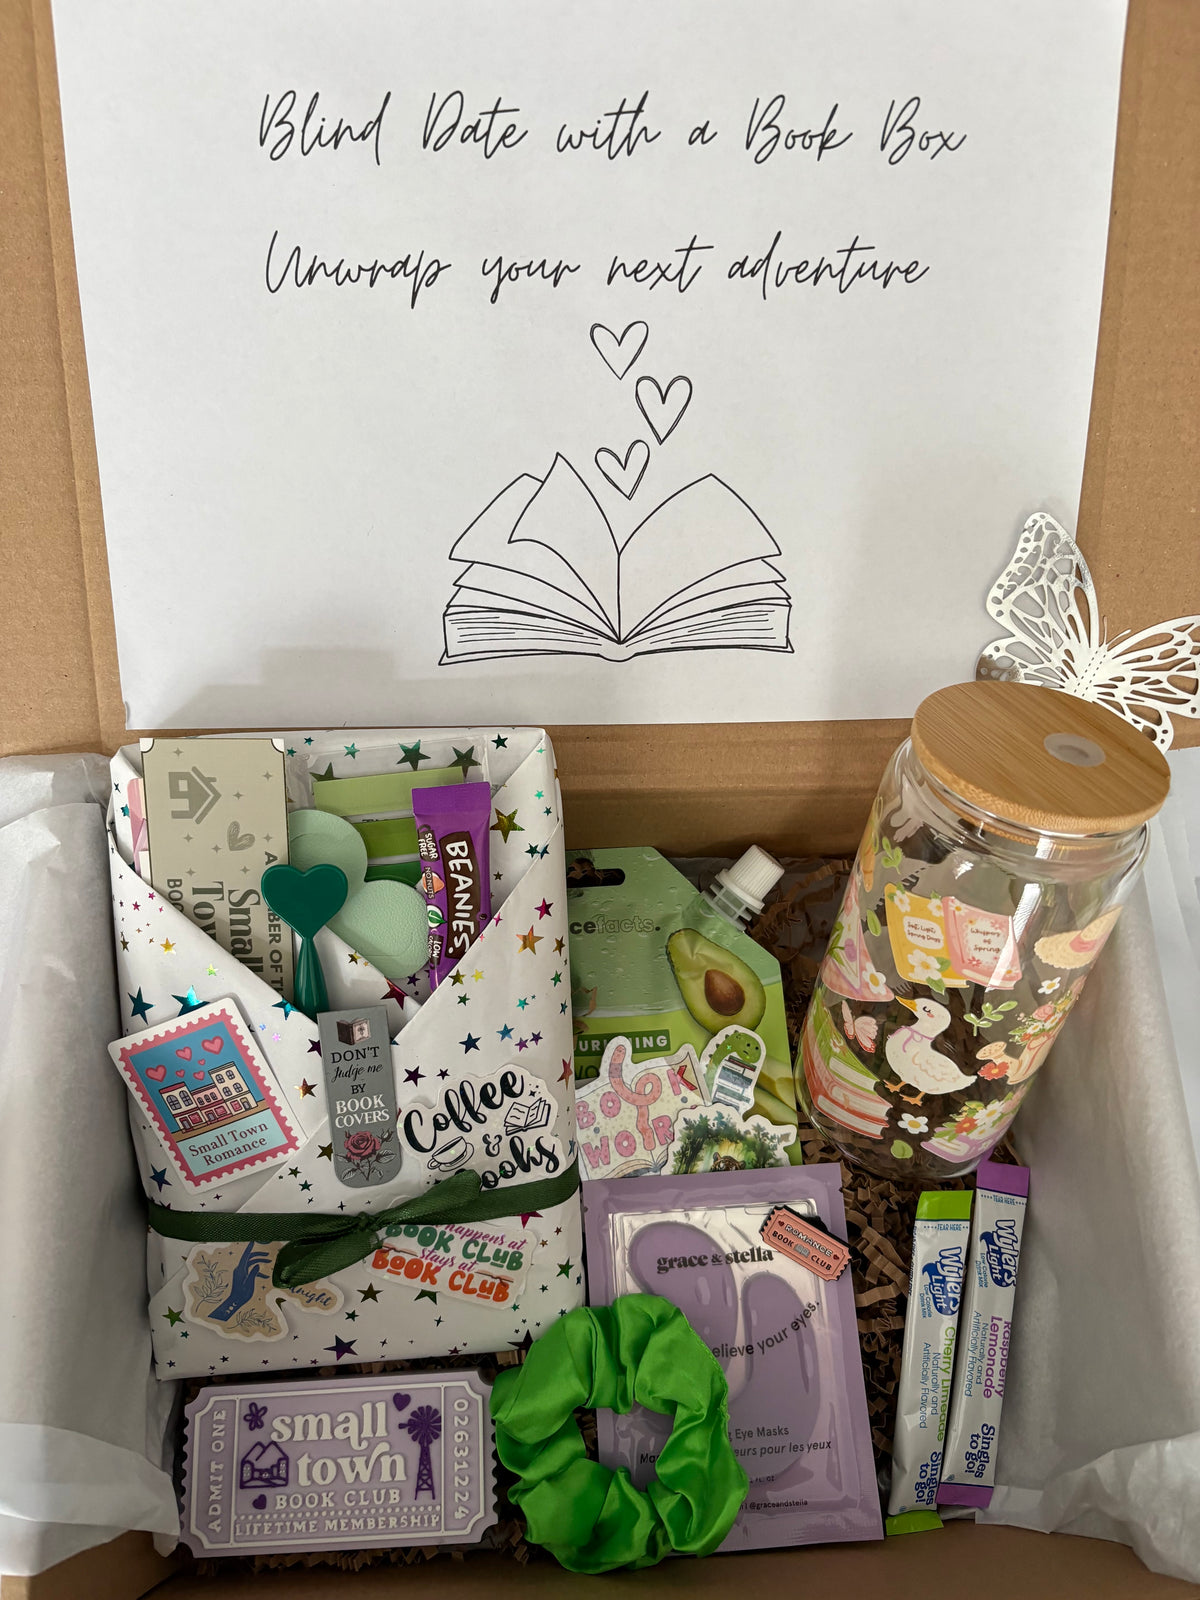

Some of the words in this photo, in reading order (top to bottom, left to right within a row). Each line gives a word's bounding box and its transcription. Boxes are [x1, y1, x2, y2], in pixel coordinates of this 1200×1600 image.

[259, 91, 391, 165] Blind
[423, 91, 528, 150] Date
[556, 91, 661, 158] with
[688, 119, 718, 146] a
[745, 94, 853, 164] Book
[880, 96, 967, 165] Box
[264, 230, 452, 310] Unwrap
[481, 256, 581, 304] your
[607, 235, 714, 292] next
[727, 230, 930, 301] adventure
[265, 851, 278, 866] A
[418, 838, 429, 857] FREE
[424, 832, 439, 860] SUGAR
[424, 866, 432, 878] NO
[425, 878, 434, 899] NUTS
[267, 908, 282, 945] BER
[569, 915, 661, 935] cefacts.
[269, 949, 283, 973] OF
[432, 940, 442, 959] LOW
[331, 1046, 380, 1063] DON'T
[367, 1063, 384, 1073] me
[336, 1094, 386, 1114] BOOK
[351, 1083, 366, 1095] BY
[335, 1108, 390, 1129] COVERS
[403, 1070, 524, 1154] Coffee
[188, 1133, 229, 1157] Small
[227, 1122, 269, 1142] Town
[203, 1137, 268, 1166] Romance
[482, 1133, 502, 1158] &
[582, 1114, 675, 1169] WOR
[478, 1135, 560, 1190] ooks
[507, 1238, 528, 1251] at
[771, 1230, 795, 1248] BOOK
[810, 1254, 832, 1271] CLUB
[785, 1223, 834, 1257] ROMANCE
[420, 1247, 455, 1270] stays
[458, 1259, 478, 1273] at
[656, 1254, 709, 1275] grace
[711, 1253, 723, 1266] &
[725, 1245, 774, 1265] stella
[986, 1244, 1002, 1281] Light
[928, 1275, 947, 1309] Light
[711, 1343, 754, 1358] elieve
[757, 1327, 789, 1355] your
[790, 1300, 820, 1331] eyes.
[968, 1311, 982, 1355] Artificially
[977, 1322, 989, 1363] Naturally
[920, 1342, 932, 1386] Artificially
[940, 1326, 956, 1375] Cherry
[983, 1315, 1003, 1399] Lemonade
[994, 1320, 1012, 1398] Raspberry
[930, 1352, 941, 1394] Naturally
[964, 1355, 977, 1398] Flavored
[975, 1365, 983, 1385] and
[919, 1388, 930, 1429] Flavored
[930, 1397, 939, 1416] and
[937, 1378, 951, 1442] Limeade
[211, 1408, 227, 1453] ONE
[271, 1400, 388, 1451] small
[735, 1428, 753, 1441] Eye
[756, 1424, 790, 1438] Masks
[969, 1433, 981, 1450] to
[297, 1441, 407, 1487] town
[760, 1445, 786, 1458] pour
[789, 1442, 804, 1453] les
[807, 1440, 832, 1454] yeux
[965, 1451, 979, 1474] go!
[974, 1423, 996, 1479] Singles
[919, 1462, 930, 1479] to
[925, 1451, 942, 1506] Singles
[207, 1459, 225, 1533] ADMIT
[275, 1491, 336, 1511] BOOK
[344, 1488, 401, 1506] CLUB
[914, 1481, 926, 1503] go!
[235, 1518, 318, 1537] LIFETIME
[325, 1514, 441, 1533] MEMBERSHIP
